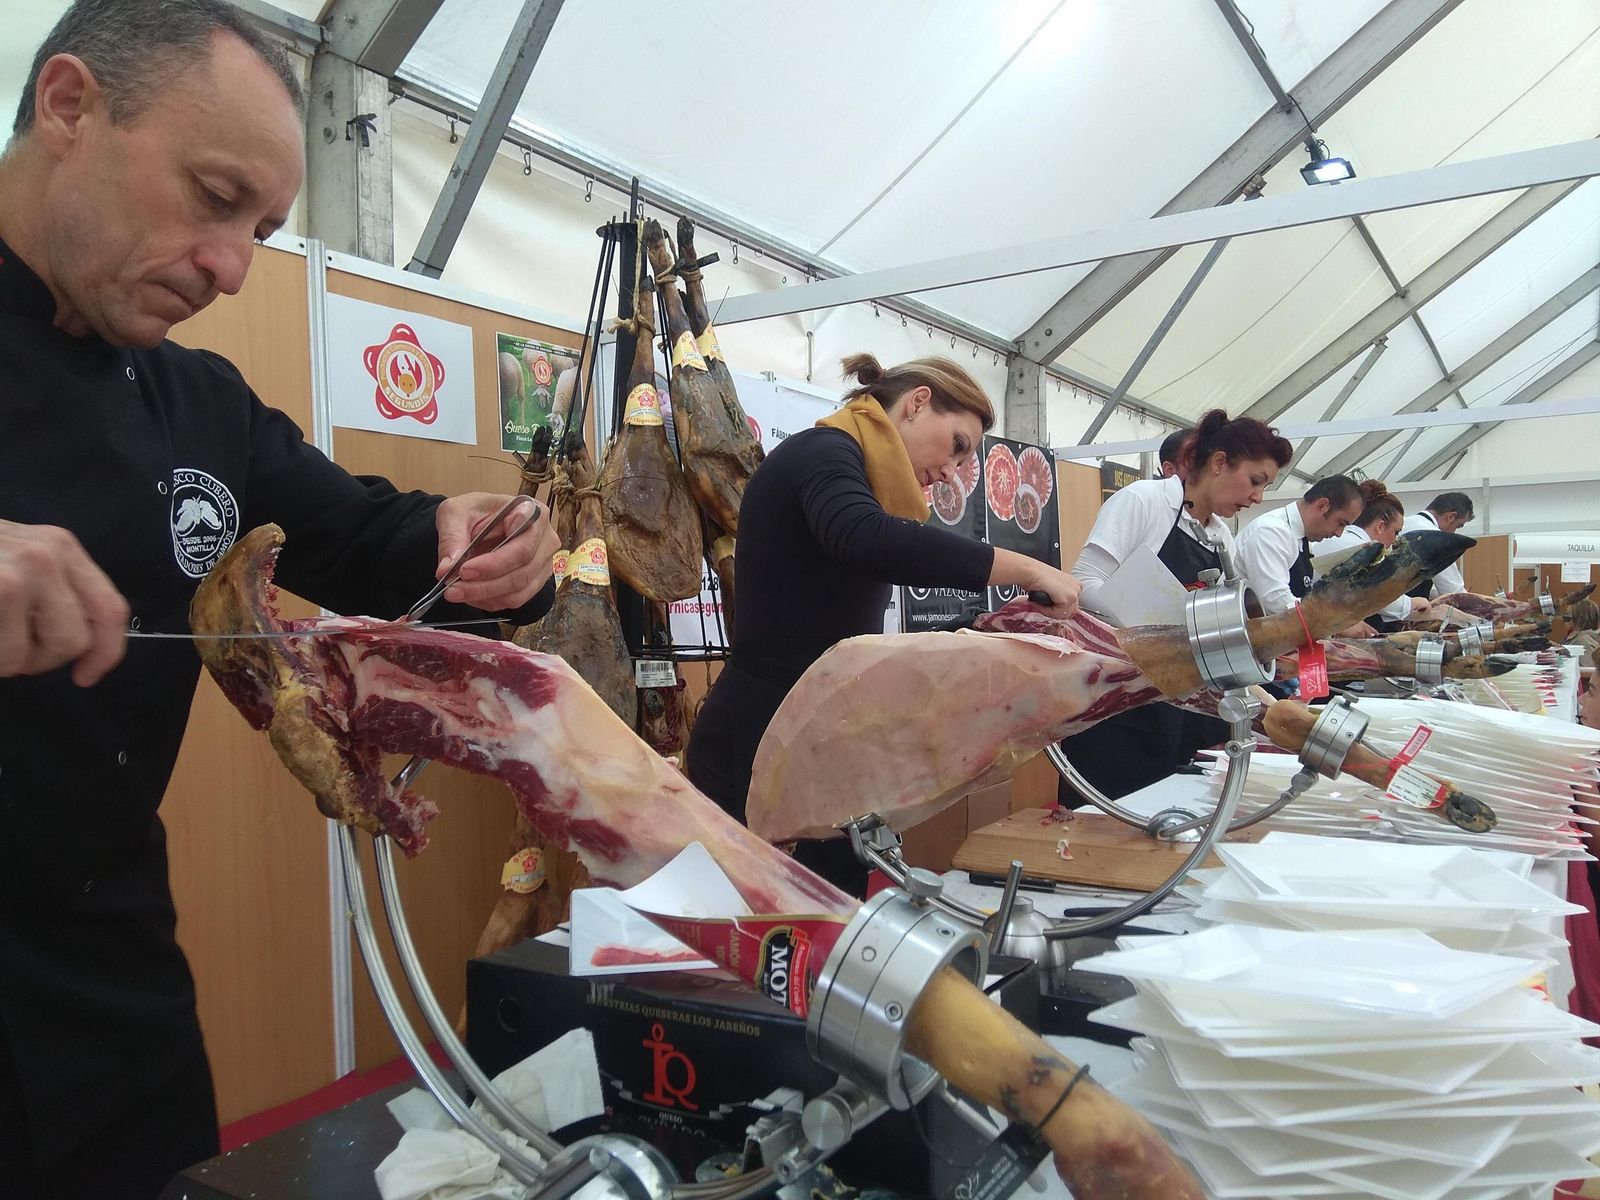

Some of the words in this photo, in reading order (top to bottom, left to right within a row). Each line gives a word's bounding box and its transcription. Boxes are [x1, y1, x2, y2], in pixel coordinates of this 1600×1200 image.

[504, 420, 530, 434] Queso
[173, 473, 195, 487] SCO
[200, 476, 234, 517] CUBERO
[186, 543, 215, 553] MONTILLA
[1567, 544, 1595, 552] TAQUILLA
[770, 944, 788, 1007] MOT
[641, 1005, 691, 1023] QUESERAS
[693, 1014, 712, 1028] LOS
[713, 1019, 761, 1037] JAREÑOS
